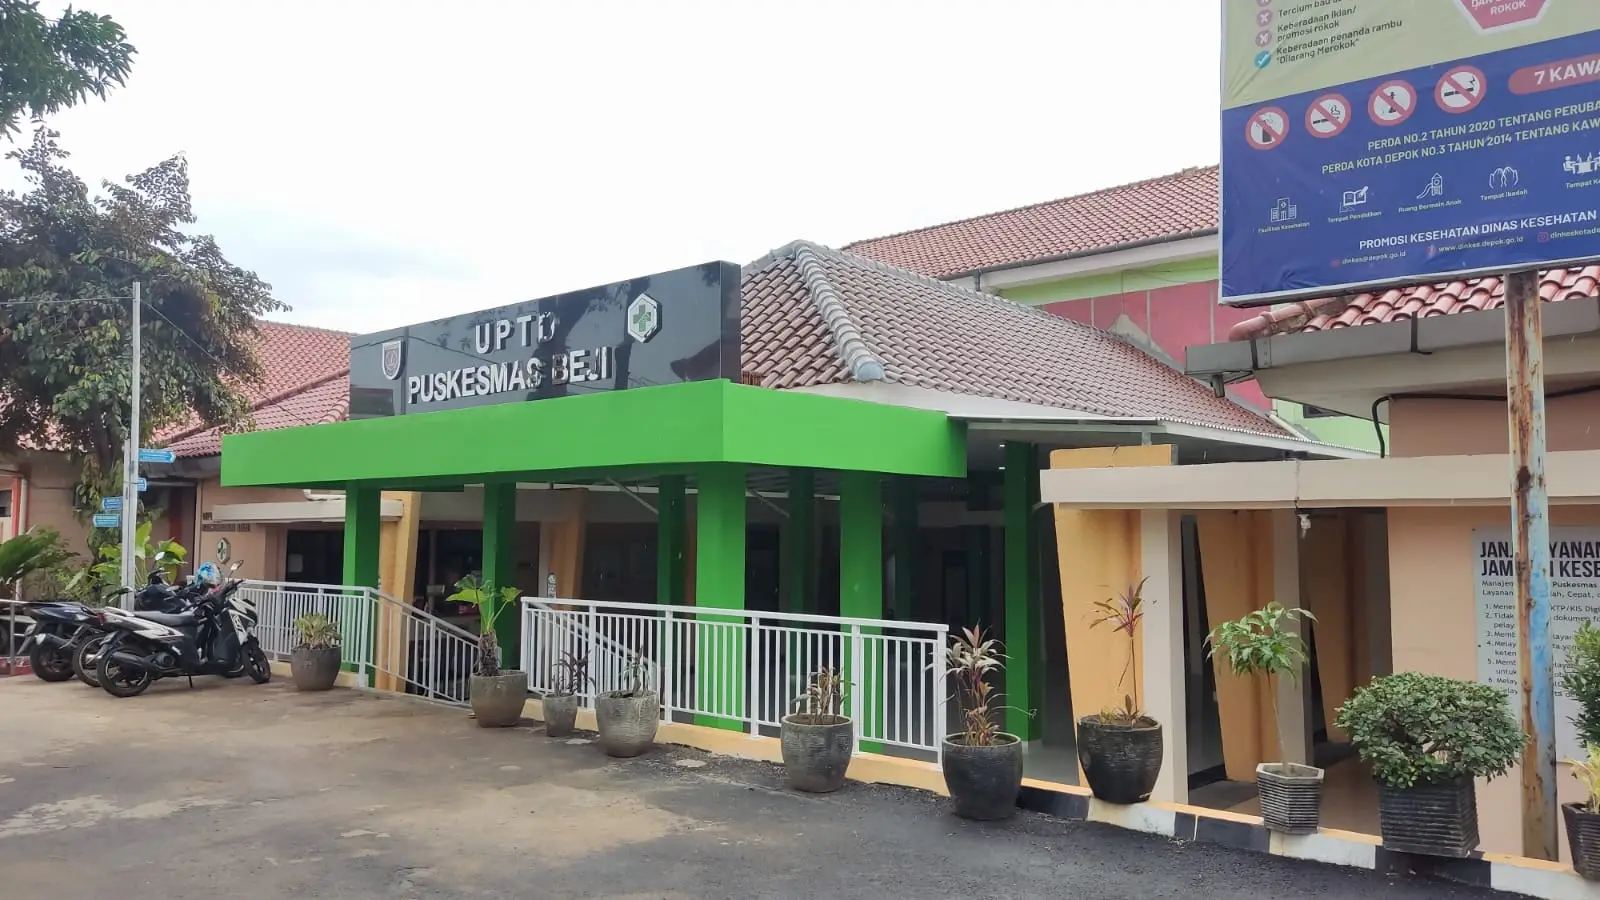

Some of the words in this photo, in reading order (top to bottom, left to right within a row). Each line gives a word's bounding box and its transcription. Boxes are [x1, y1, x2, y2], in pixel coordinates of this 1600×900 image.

[1278, 4, 1313, 17] Tercium
[1490, 0, 1526, 15] ROKOK
[1277, 14, 1329, 32] Keberadaan
[1277, 26, 1312, 42] promosi
[1314, 20, 1340, 32] rokok
[1276, 38, 1328, 55] Keberadaan
[1330, 26, 1370, 43] penanda
[1372, 19, 1402, 33] rambu
[1534, 70, 1545, 85] 7
[1368, 138, 1401, 151] PERDA
[1403, 132, 1428, 145] NO.2
[1430, 124, 1466, 139] TAHUN
[1469, 119, 1496, 133] 2020
[1498, 109, 1552, 128] TENTANG
[1321, 161, 1355, 175] PERDA
[1356, 156, 1383, 169] KOTA
[1385, 149, 1419, 164] DEPOK
[1421, 144, 1446, 157] NO.3
[1447, 138, 1485, 152] TAHUN
[1487, 133, 1512, 146] 2014
[1515, 123, 1570, 141] TENTANG
[1565, 180, 1592, 190] Tempat
[1480, 191, 1504, 201] Tempat
[1360, 234, 1408, 250] PROMOSI
[1410, 225, 1479, 243] KESEHATAN
[1481, 220, 1518, 234] DINAS
[1520, 210, 1597, 229] KESEHATAN
[475, 311, 557, 354] UPTD
[408, 357, 543, 405] PUSKESMAS
[551, 346, 609, 386] BEJI
[1480, 541, 1514, 558] JAN
[1481, 560, 1514, 577] JAM
[1560, 560, 1600, 578] KESE
[1482, 589, 1514, 598] Layanan
[1552, 581, 1597, 589] Puskesmas
[1494, 641, 1516, 649] Melay
